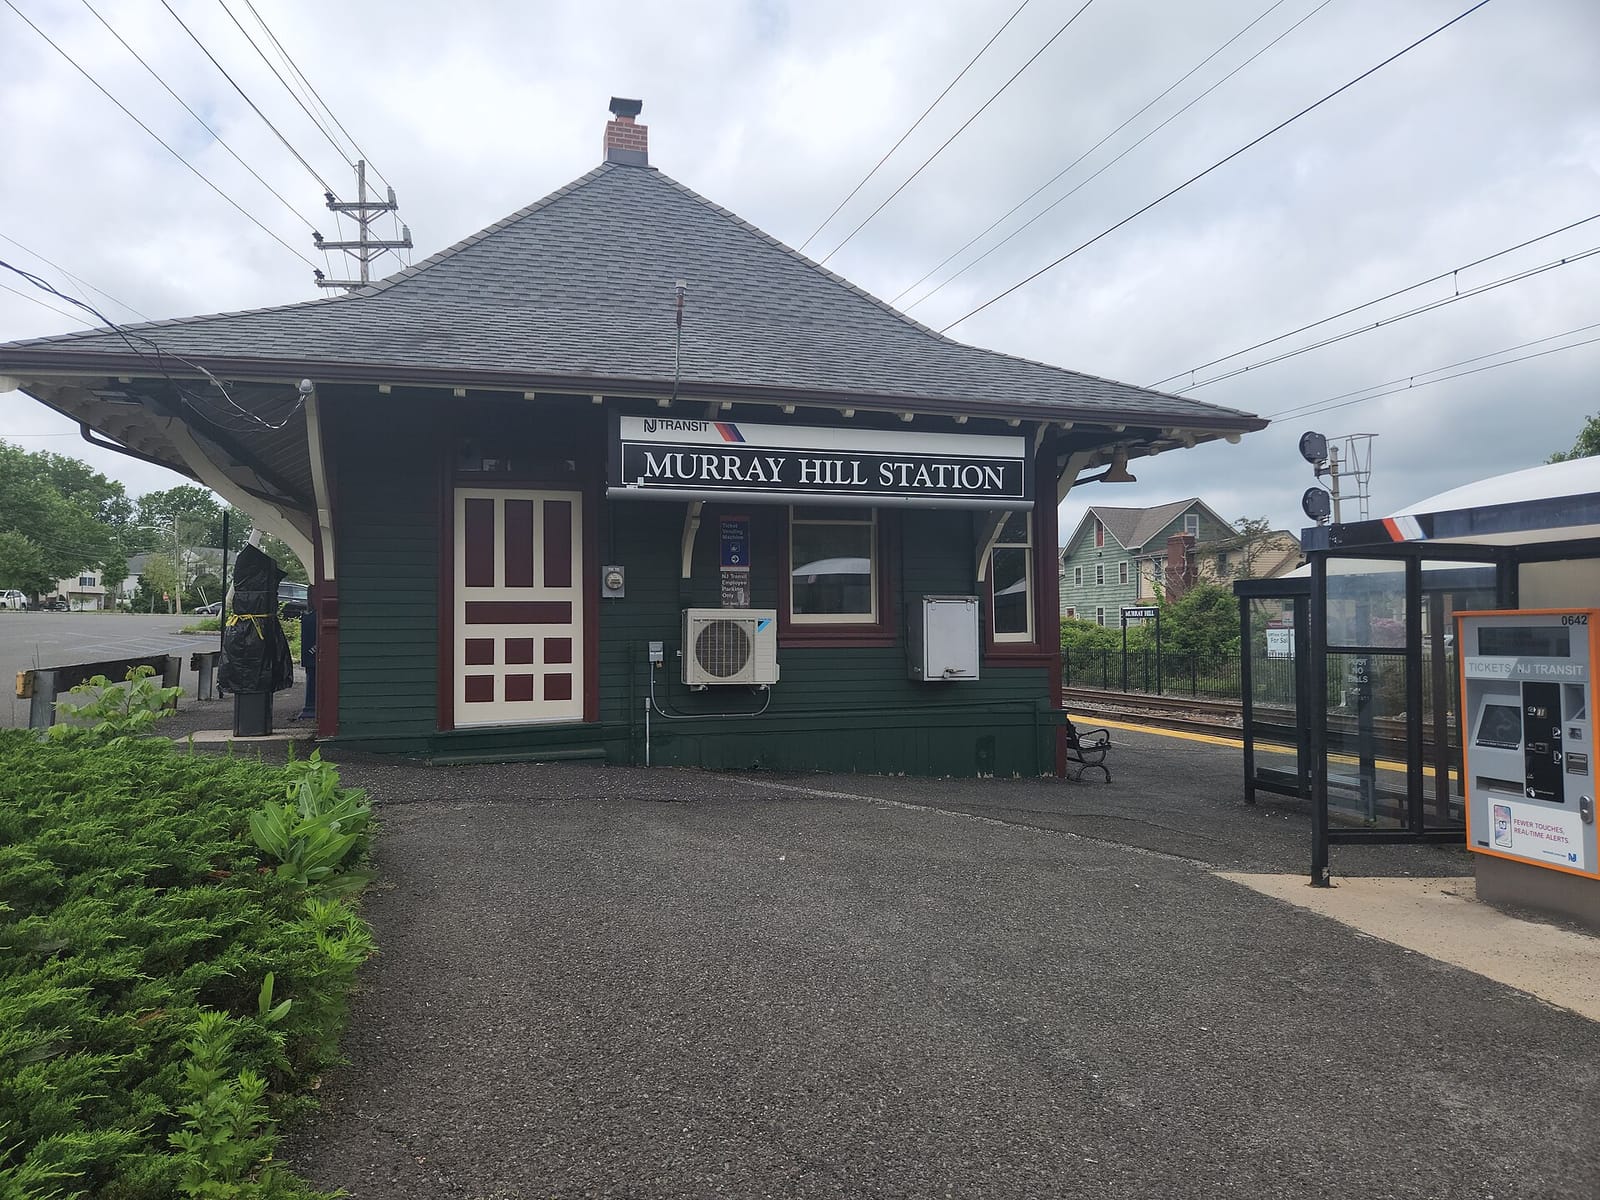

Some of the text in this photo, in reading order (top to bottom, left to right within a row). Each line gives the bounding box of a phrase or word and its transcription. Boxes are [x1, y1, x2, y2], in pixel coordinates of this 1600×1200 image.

[643, 419, 710, 433] NJ TRANSIT
[643, 451, 1005, 490] MURRAY HILL STATION
[1561, 615, 1588, 626] 0642
[1469, 662, 1584, 676] TICKETS NJ TRANSIT
[1513, 818, 1534, 829] FEWER
[1513, 827, 1569, 844] REAL-TIME ALERTS
